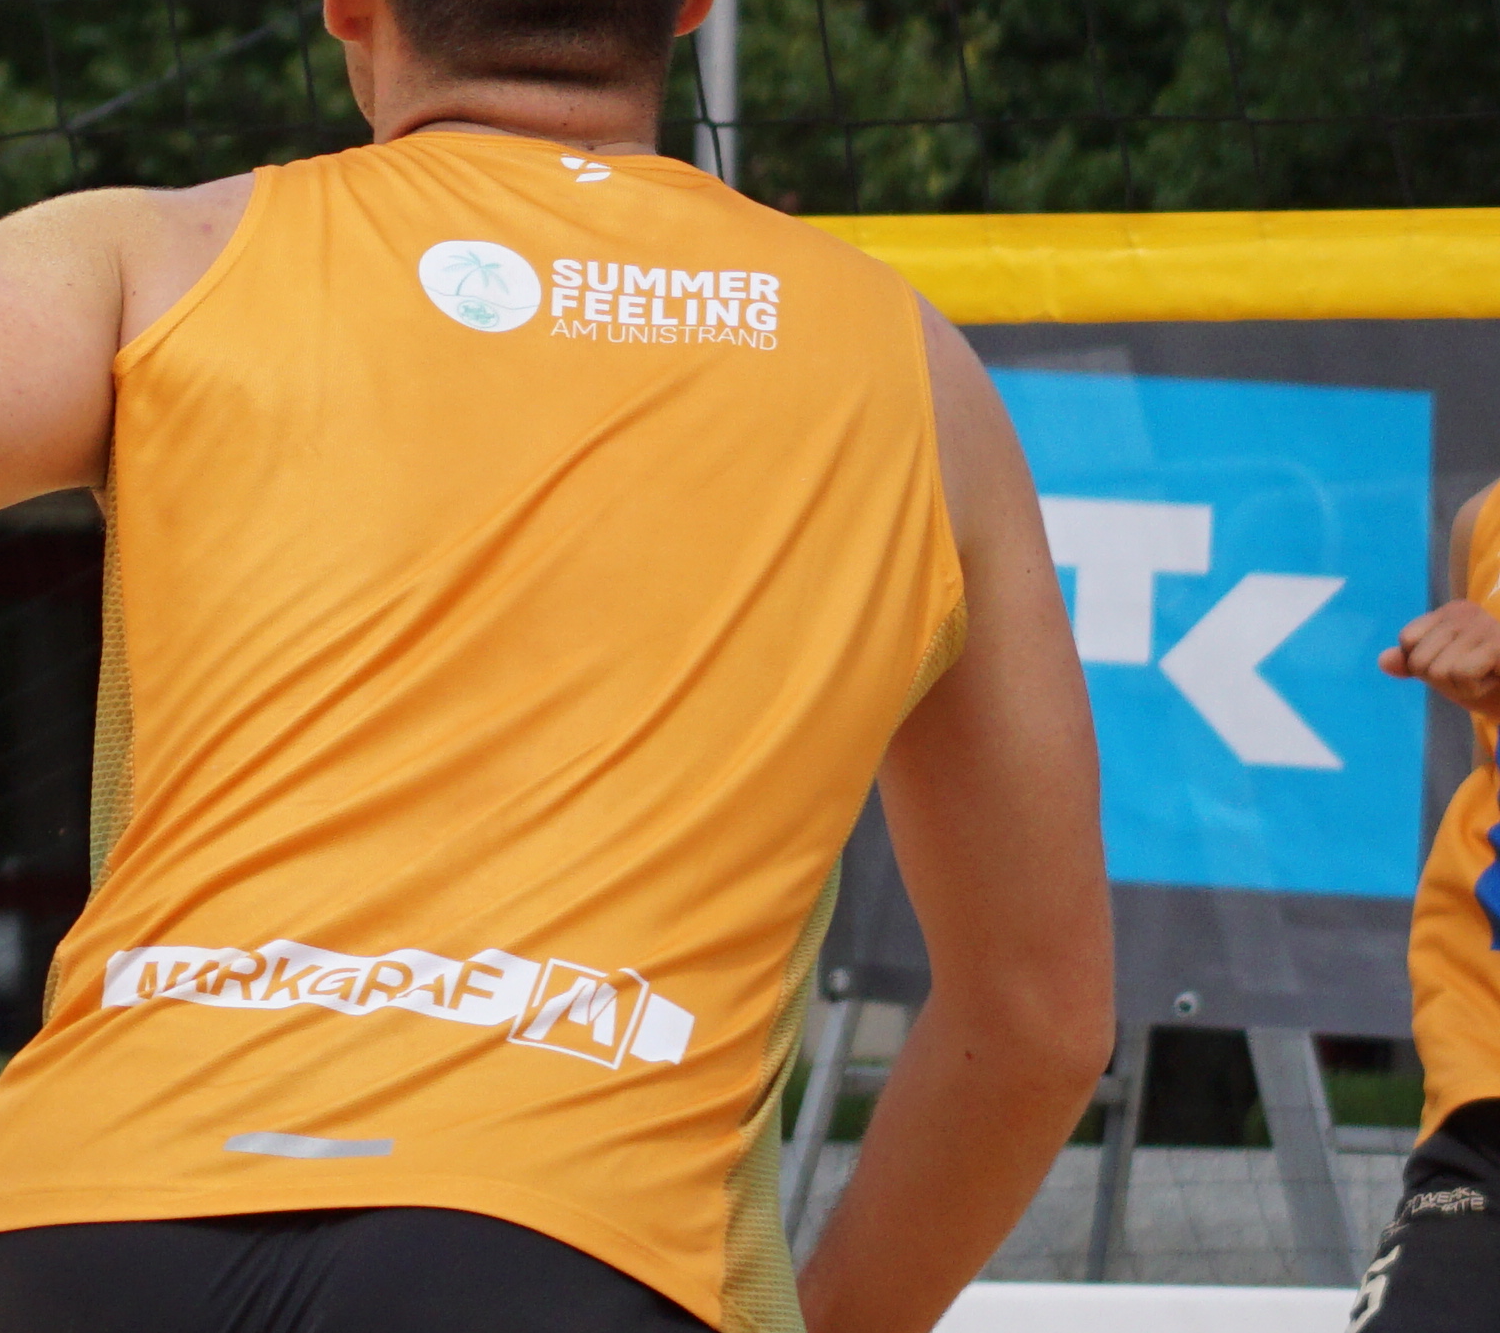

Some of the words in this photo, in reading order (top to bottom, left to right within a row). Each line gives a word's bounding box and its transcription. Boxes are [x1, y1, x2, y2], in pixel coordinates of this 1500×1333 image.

[551, 258, 780, 303] SUMMER
[550, 287, 778, 331] FEELING
[550, 318, 598, 342] AM
[607, 323, 777, 351] UNISTRAND
[1038, 493, 1347, 771] TK
[136, 951, 504, 1011] MARKGRAF
